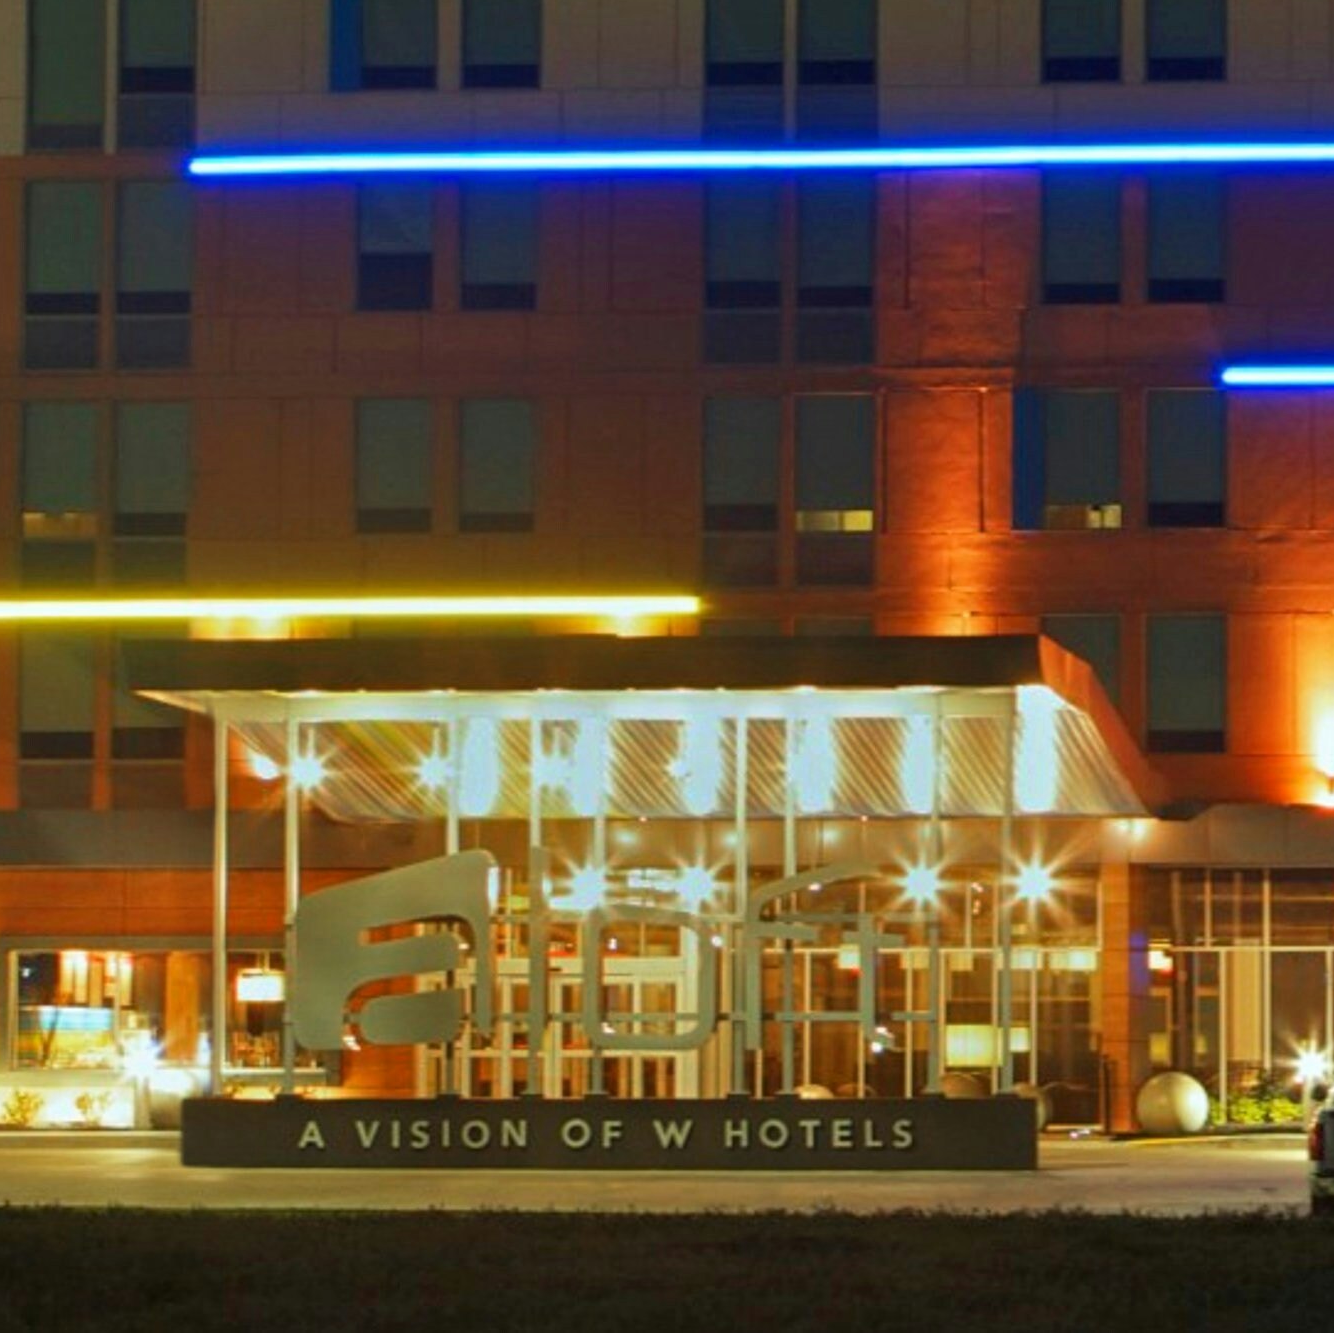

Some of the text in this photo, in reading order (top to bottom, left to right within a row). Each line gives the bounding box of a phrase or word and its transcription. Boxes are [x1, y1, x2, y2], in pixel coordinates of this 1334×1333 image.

[293, 847, 905, 1051] aloft
[298, 1118, 914, 1149] A VISION OF W HOTELS
